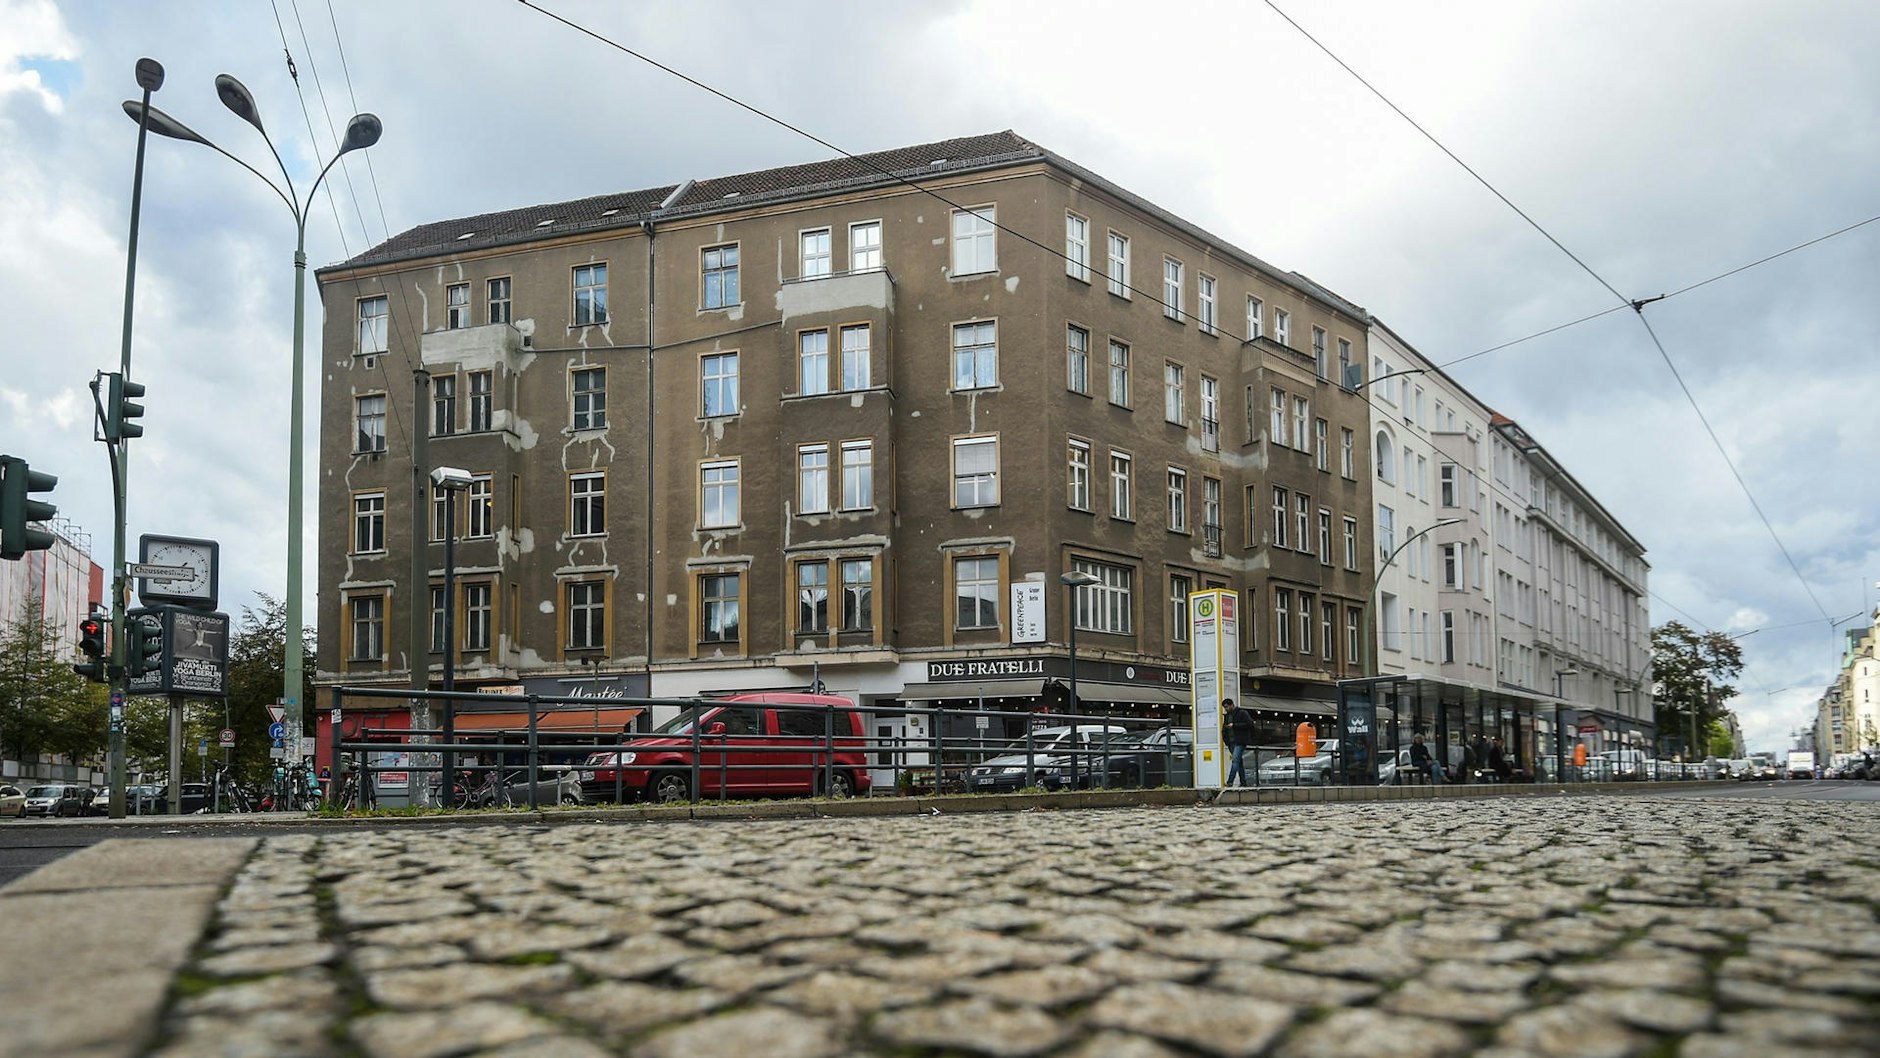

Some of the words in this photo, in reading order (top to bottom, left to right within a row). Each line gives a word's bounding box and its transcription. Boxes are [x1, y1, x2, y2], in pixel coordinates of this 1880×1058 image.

[1016, 588, 1026, 637] GREENPEACE
[1202, 603, 1209, 613] H
[200, 616, 216, 624] CHILD
[176, 661, 217, 671] JIVAMUKTI
[930, 664, 966, 677] DUE
[967, 660, 1044, 675] FRATELLI
[172, 667, 195, 676] YOGA
[195, 668, 222, 678] BERLIN
[1165, 671, 1187, 684] DUE
[1347, 725, 1368, 733] Wall
